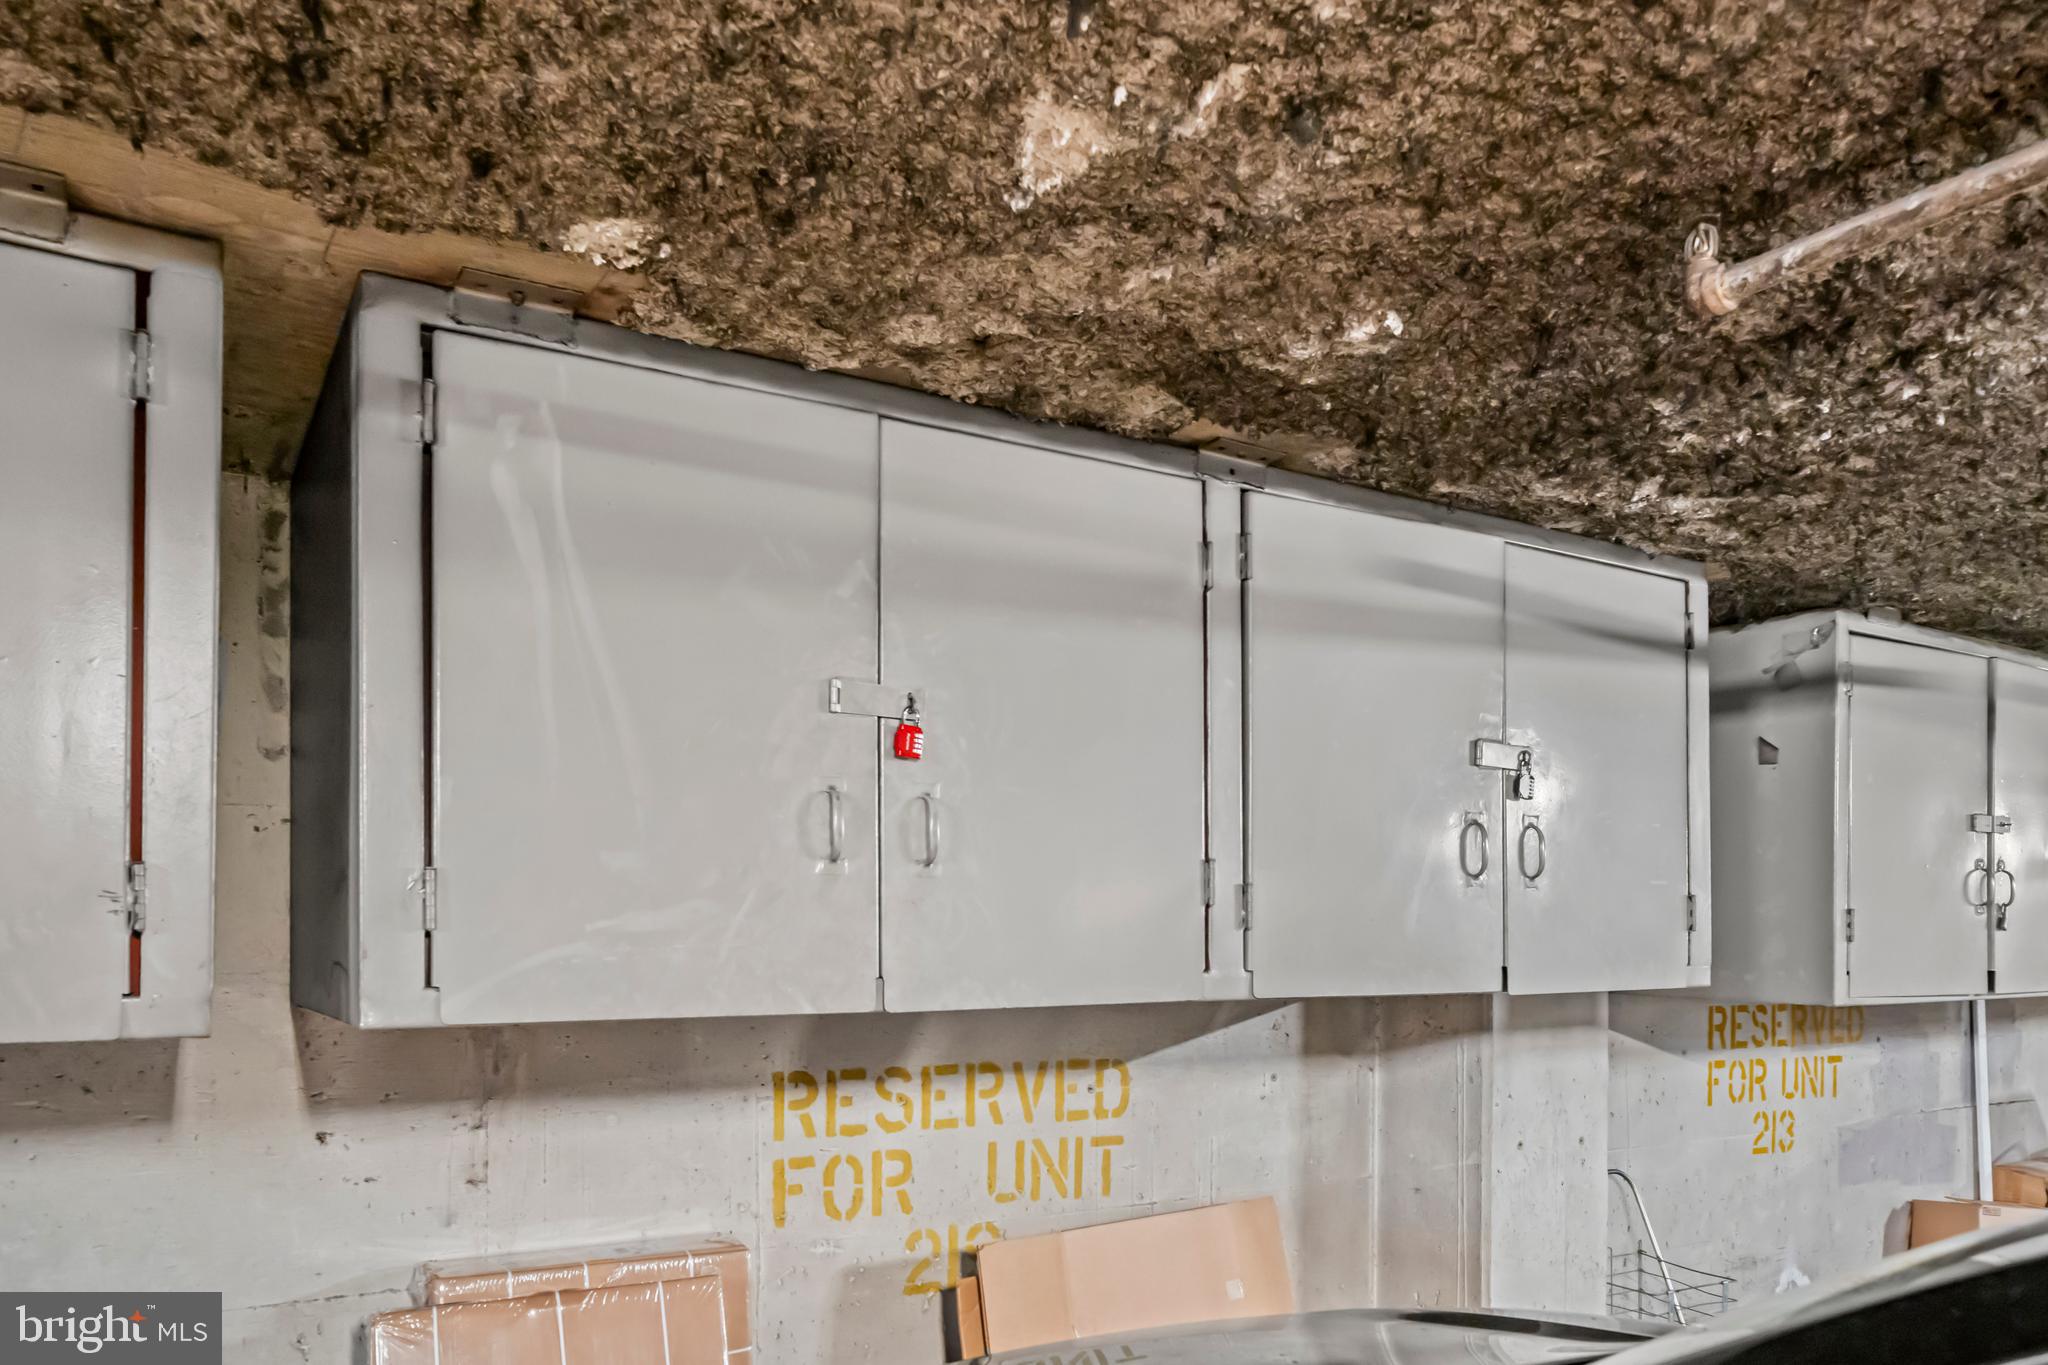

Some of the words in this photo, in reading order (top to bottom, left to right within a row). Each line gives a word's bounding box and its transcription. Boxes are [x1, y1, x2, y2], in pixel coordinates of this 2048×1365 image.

[1708, 1003, 1865, 1050] RESERVED
[772, 1058, 1131, 1142] RESERVED
[1707, 1058, 1768, 1106] FOR
[1781, 1055, 1843, 1100] UNIT
[1752, 1109, 1796, 1155] 213
[772, 1149, 914, 1229] FOR
[987, 1135, 1125, 1203] UNIT
